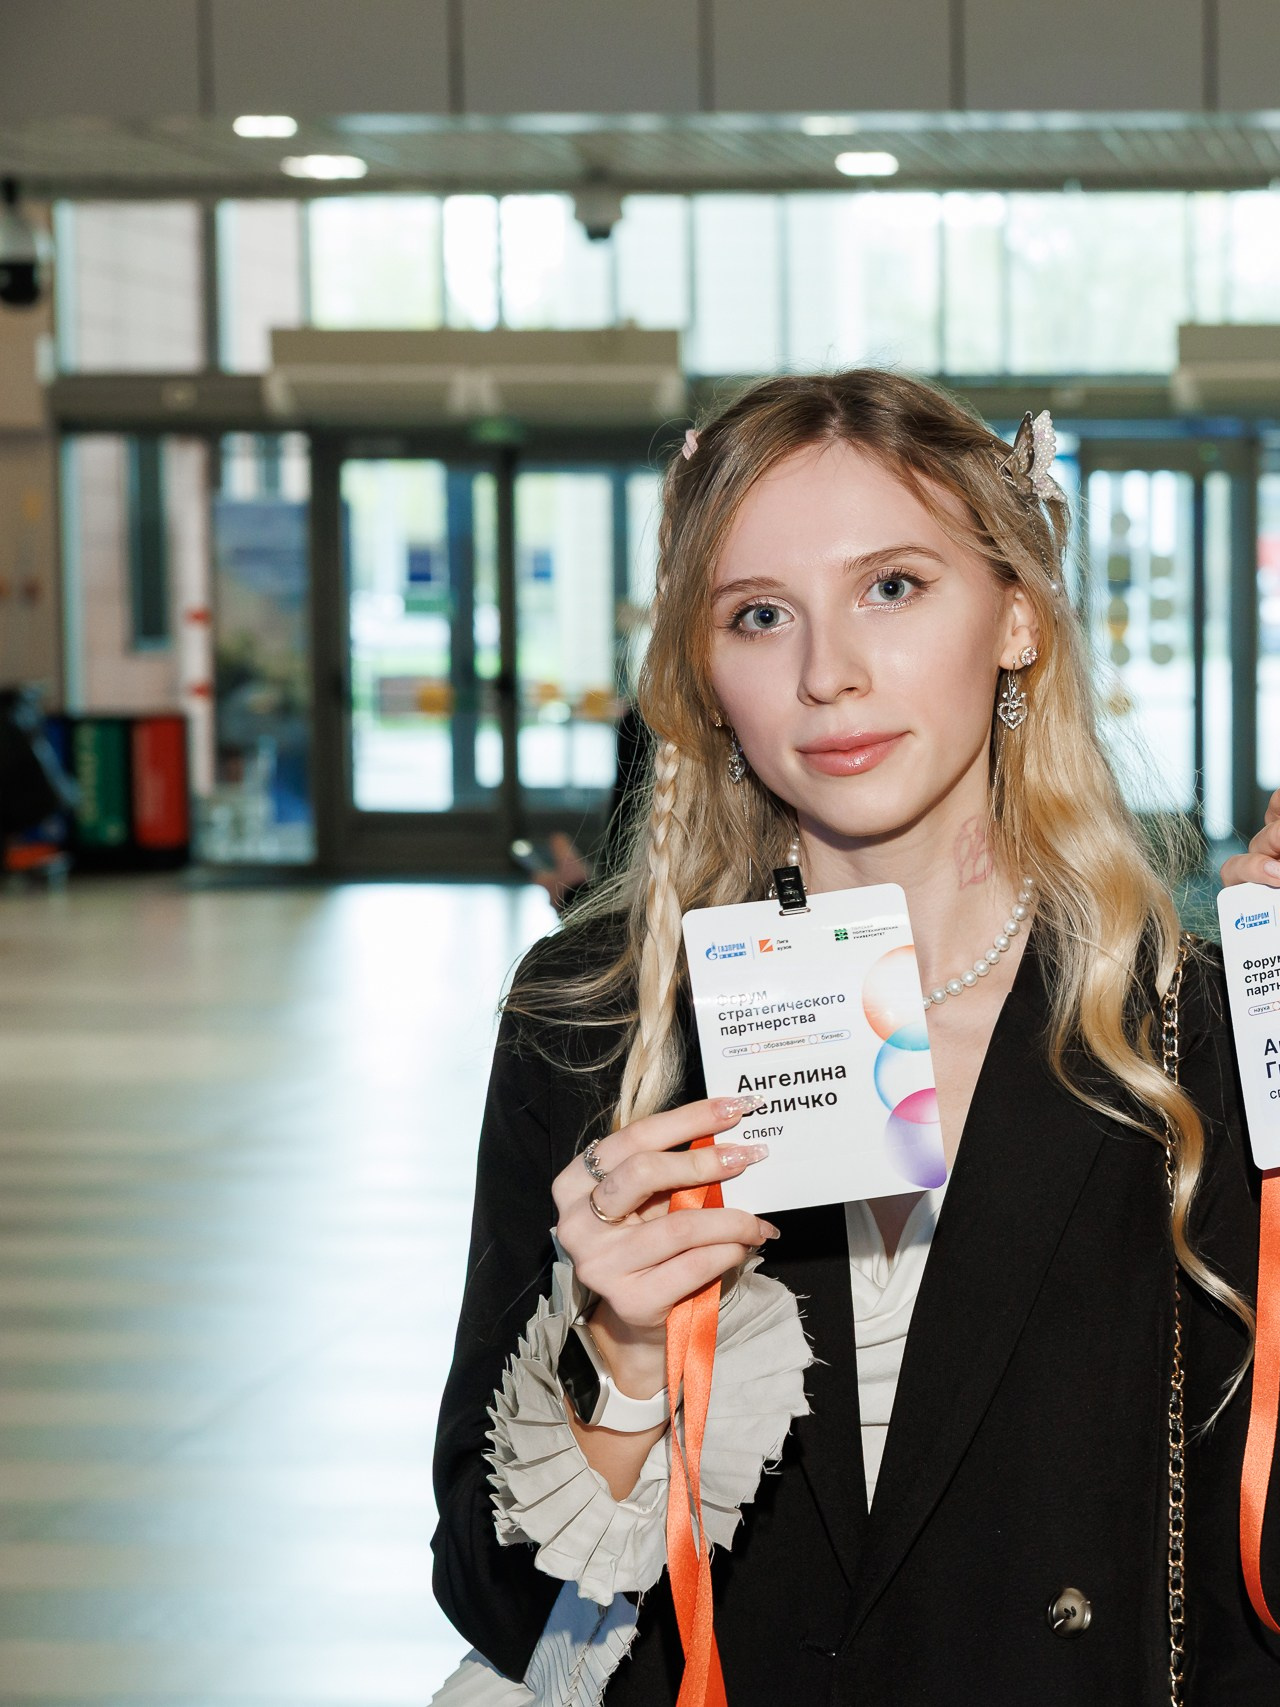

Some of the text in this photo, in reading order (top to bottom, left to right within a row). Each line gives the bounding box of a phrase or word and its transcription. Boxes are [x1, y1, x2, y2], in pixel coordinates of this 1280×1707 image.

[718, 942, 746, 953] ГАЗПРОМ
[717, 990, 767, 1006] Форум
[718, 994, 846, 1021] стратегического
[1253, 1005, 1270, 1013] наука
[720, 1013, 816, 1036] партнерства
[729, 1032, 844, 1055] наука образование бизнес
[737, 1064, 847, 1093] Ангелина
[742, 1091, 838, 1118] еличко
[743, 1126, 784, 1140] СПбПУ
